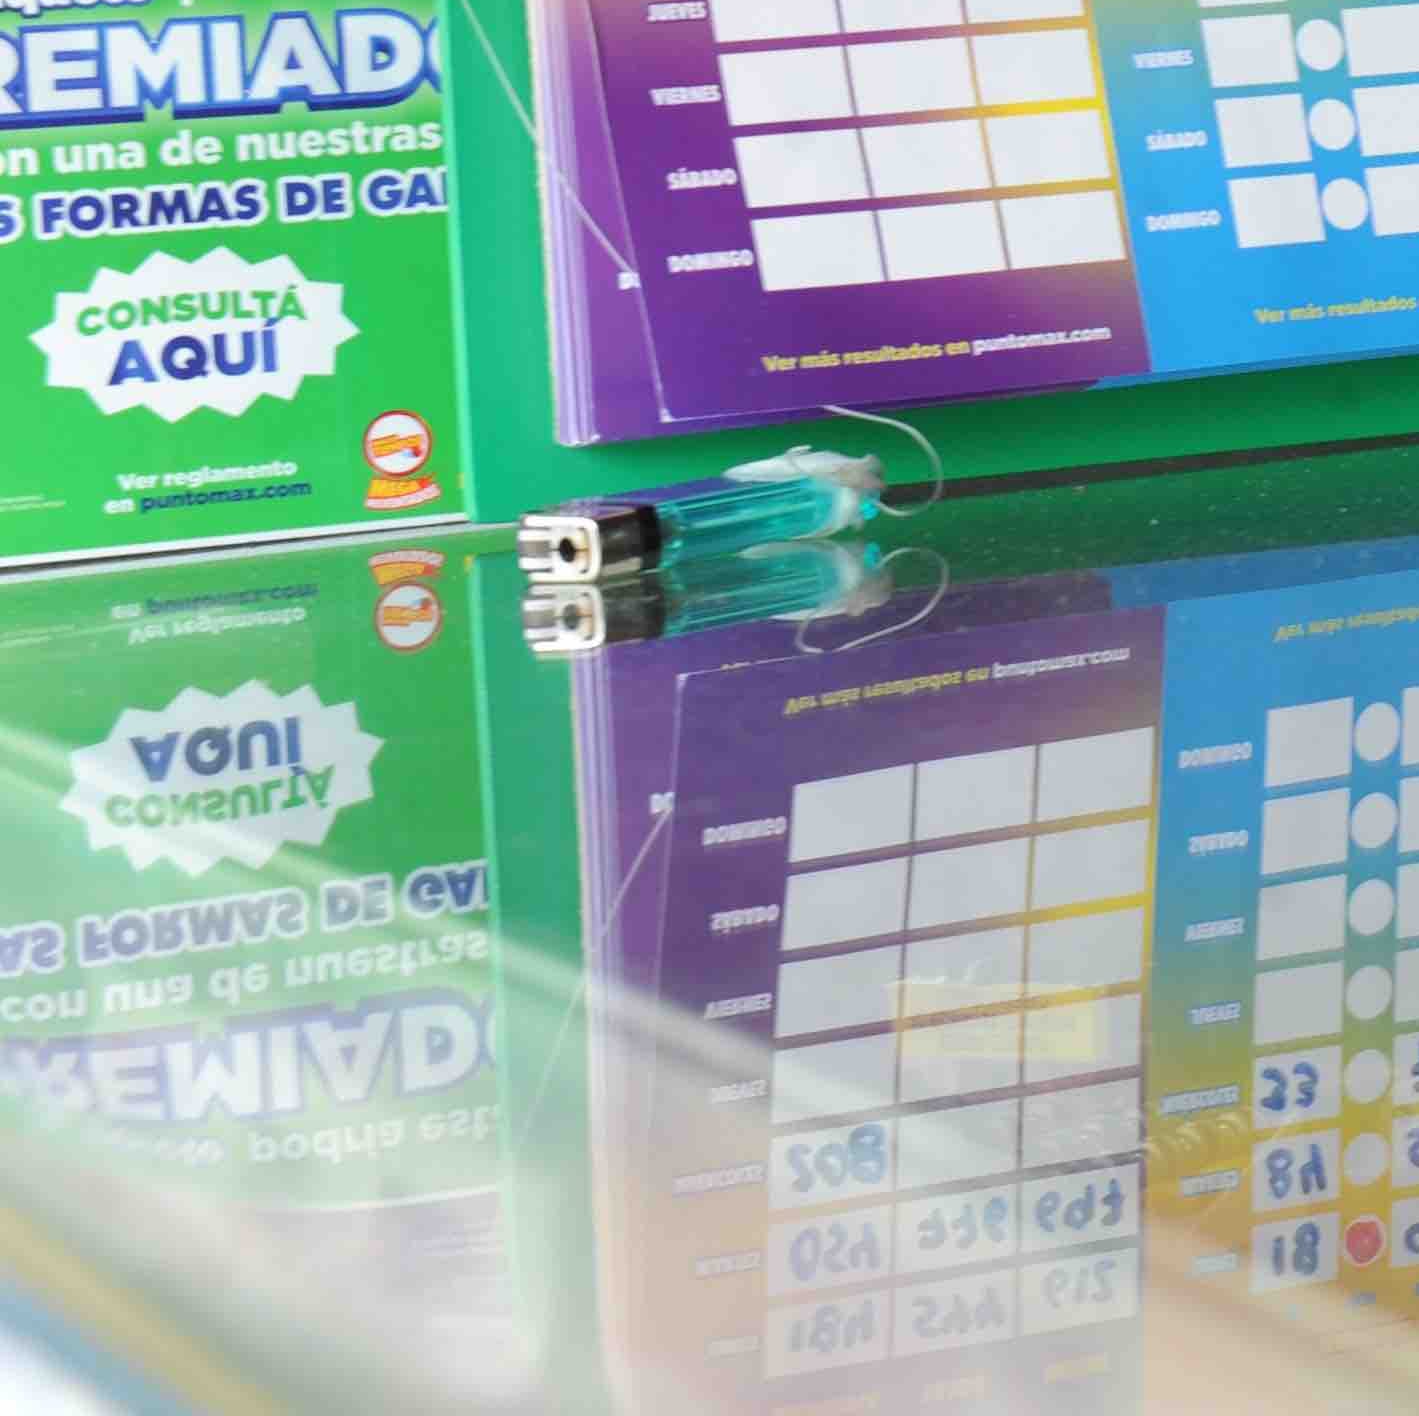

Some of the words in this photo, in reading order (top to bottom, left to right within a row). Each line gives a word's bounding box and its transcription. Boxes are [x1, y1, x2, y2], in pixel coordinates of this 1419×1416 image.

[647, 1, 707, 22] JUEVES
[0, 12, 442, 116] REMIAD
[650, 85, 721, 106] VIERNES
[54, 138, 145, 174] una
[160, 130, 222, 167] de
[236, 121, 442, 161] nuestras
[40, 185, 260, 234] FORMAS
[284, 179, 345, 216] DE
[1146, 210, 1221, 232] DOMINGO
[668, 249, 753, 273] DOMINGO
[76, 286, 306, 337] CONSULTÁ
[107, 317, 280, 386] AQUÍ
[761, 353, 796, 372] Ver
[801, 347, 839, 367] más
[843, 341, 941, 365] resultados
[945, 342, 970, 356] en
[117, 472, 163, 493] Ver
[167, 459, 298, 490] reglamento
[104, 498, 134, 515] en
